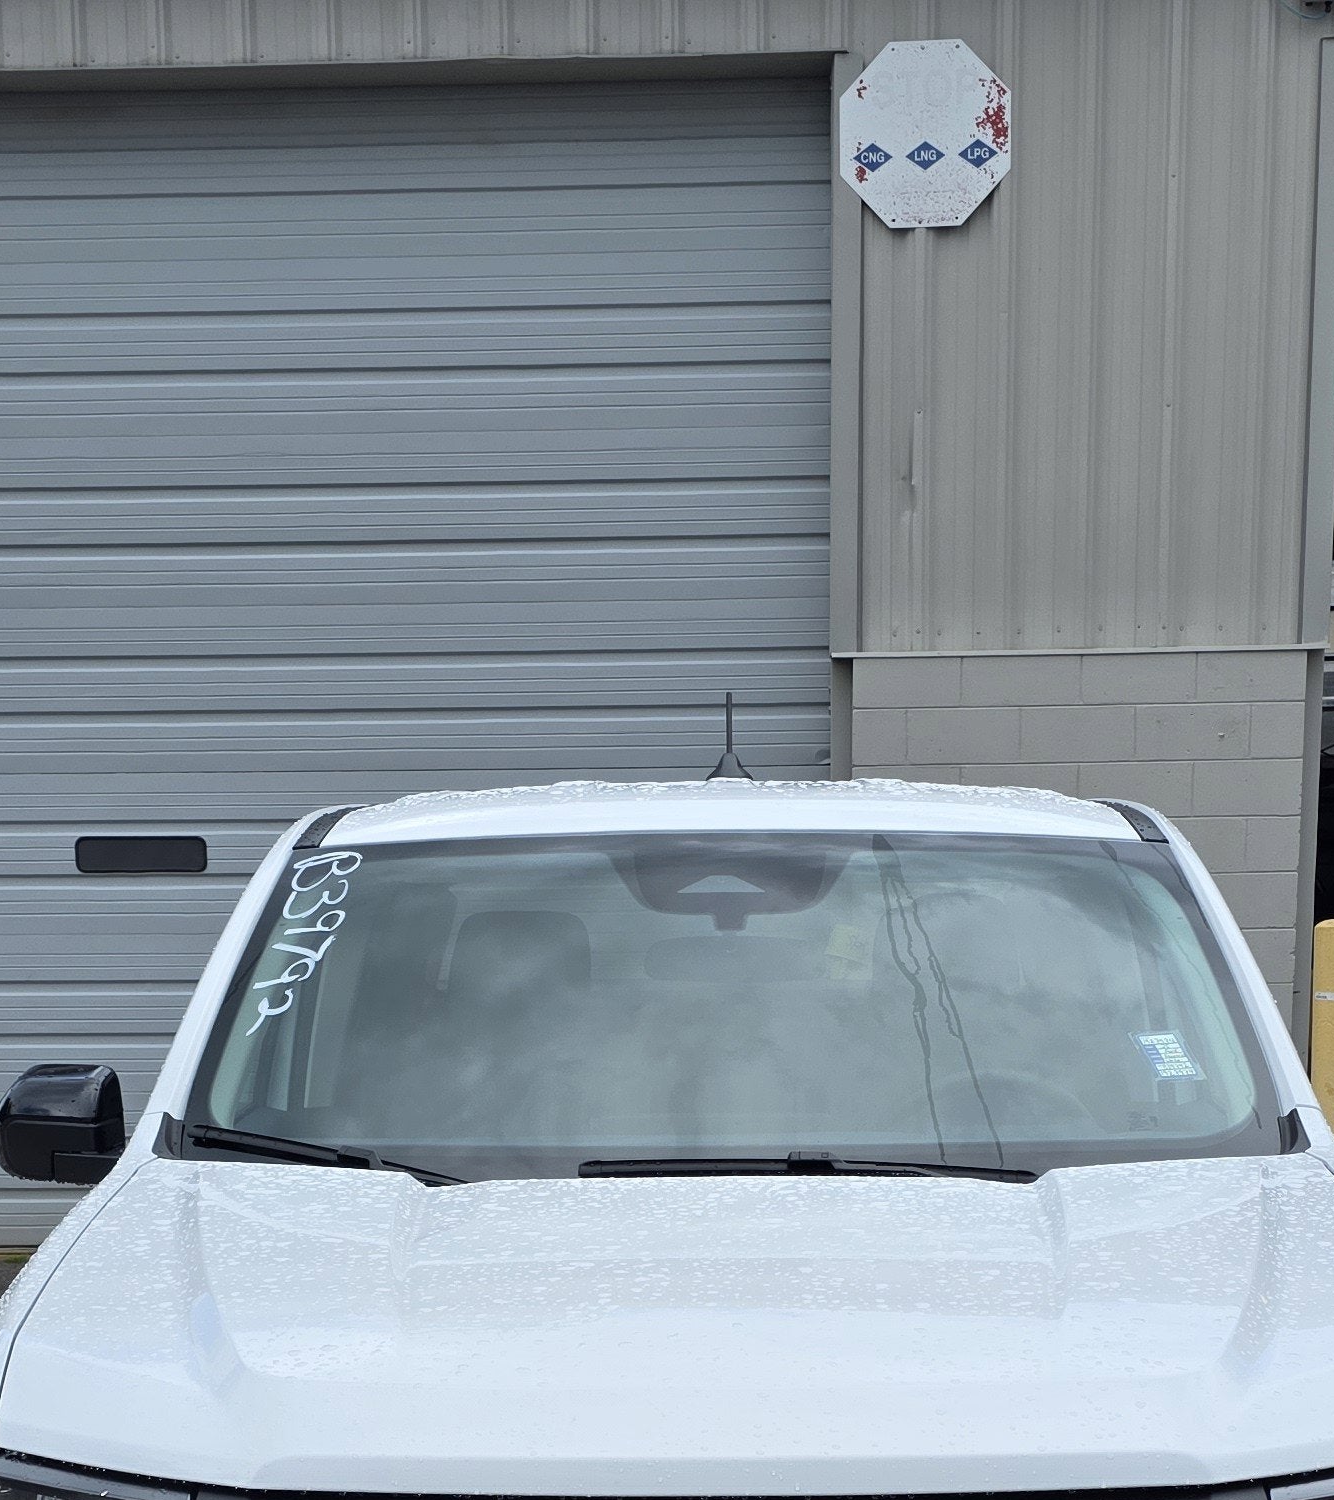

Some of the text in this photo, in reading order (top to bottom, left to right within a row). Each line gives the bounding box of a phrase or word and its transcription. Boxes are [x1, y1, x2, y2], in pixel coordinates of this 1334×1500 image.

[860, 151, 885, 163] CNG
[914, 149, 937, 161] LNG
[967, 147, 990, 159] LPG
